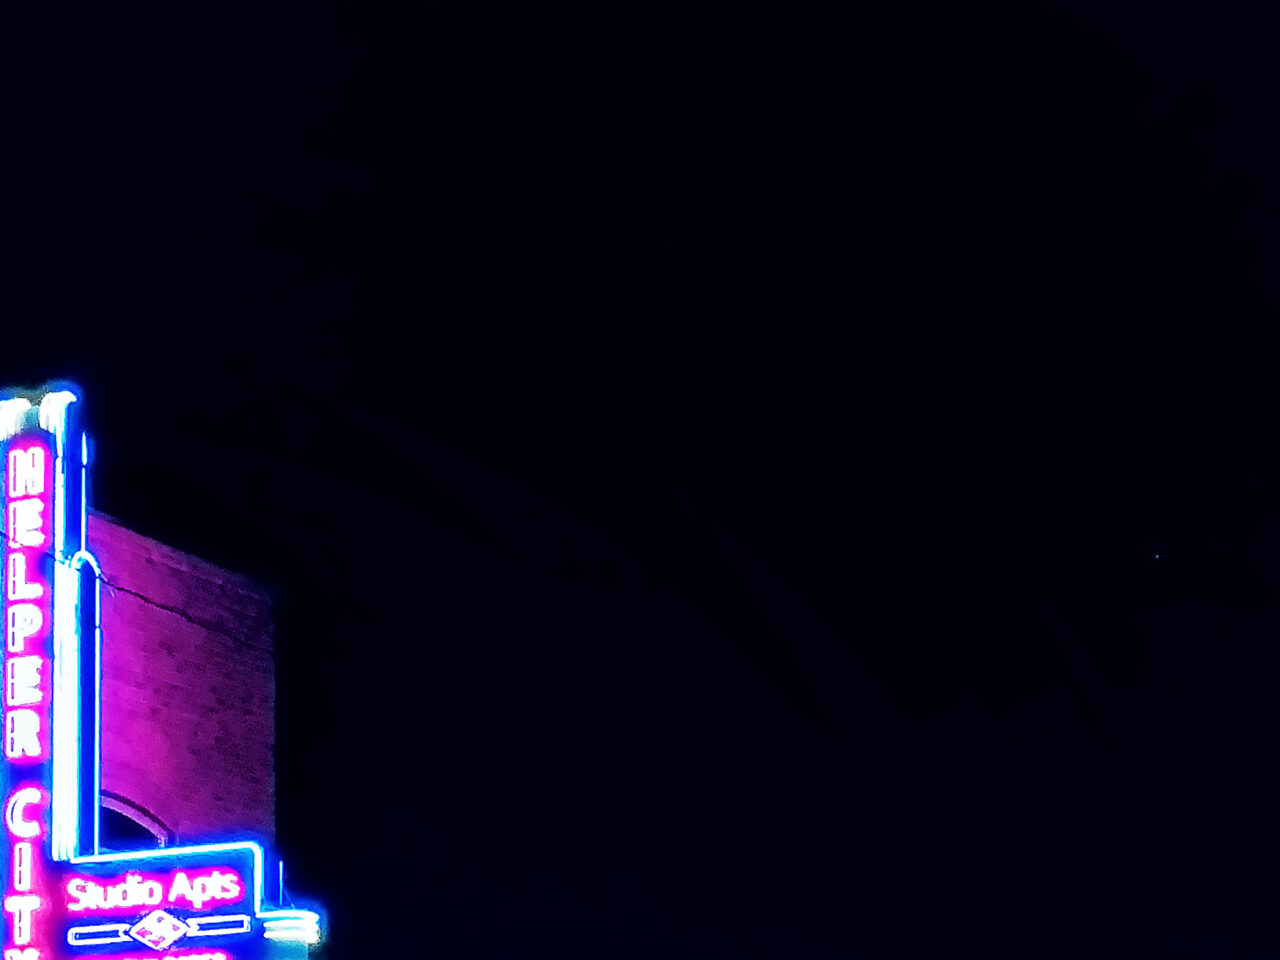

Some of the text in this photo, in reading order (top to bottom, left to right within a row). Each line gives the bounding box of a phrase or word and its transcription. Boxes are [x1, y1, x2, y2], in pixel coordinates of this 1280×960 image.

[6, 445, 46, 759] HELPER
[67, 870, 242, 911] Studio Apts
